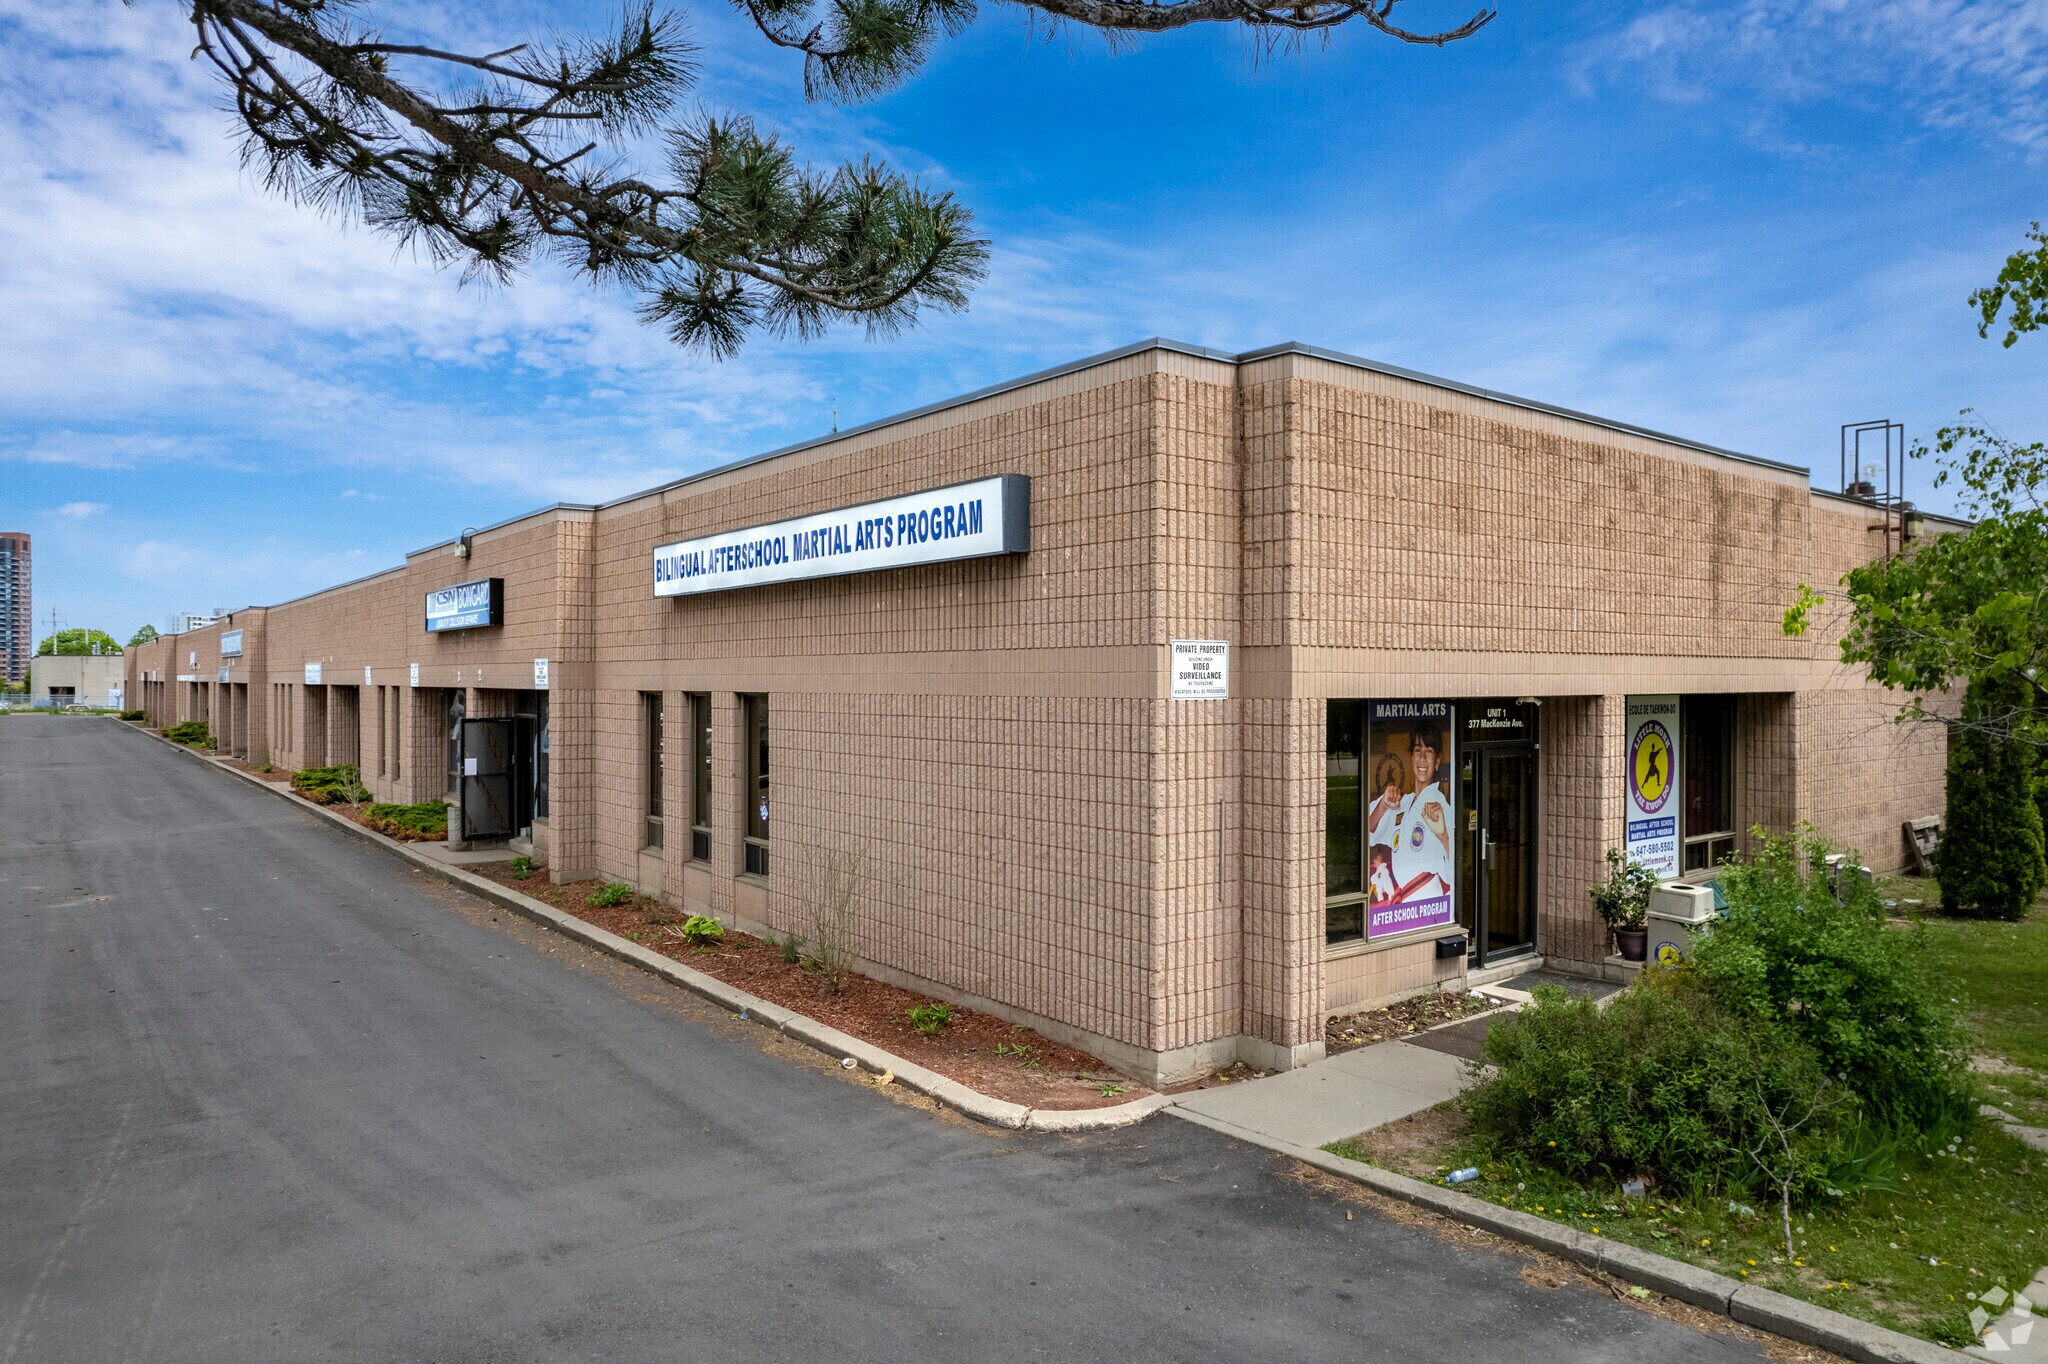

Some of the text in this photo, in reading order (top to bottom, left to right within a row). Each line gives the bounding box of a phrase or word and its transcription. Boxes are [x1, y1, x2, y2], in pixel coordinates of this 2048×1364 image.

[656, 499, 983, 582] BILINGUAL AFTERSCHOOL MARTIAL ARTS PROGRAM
[437, 590, 456, 605] CSN
[458, 582, 488, 608] BONGARD
[1176, 644, 1225, 654] PRIVATE PROPERTY
[1376, 703, 1446, 717] MARTIAL ARTS
[1488, 708, 1506, 717] UNIT 1
[1643, 704, 1649, 715] DE
[1650, 704, 1676, 714] TAEKWON-DO
[1468, 719, 1524, 728] 377 MacKenzie Ave.
[1634, 724, 1670, 750] LITTLE MONK
[1635, 785, 1670, 810] TAE KWON DO
[1630, 822, 1648, 831] BILINGUAL
[1657, 828, 1673, 836] PROGRAM
[1636, 841, 1674, 856] 647-580-5502
[1373, 901, 1447, 926] AFTER SCHOOL PROGRAM
